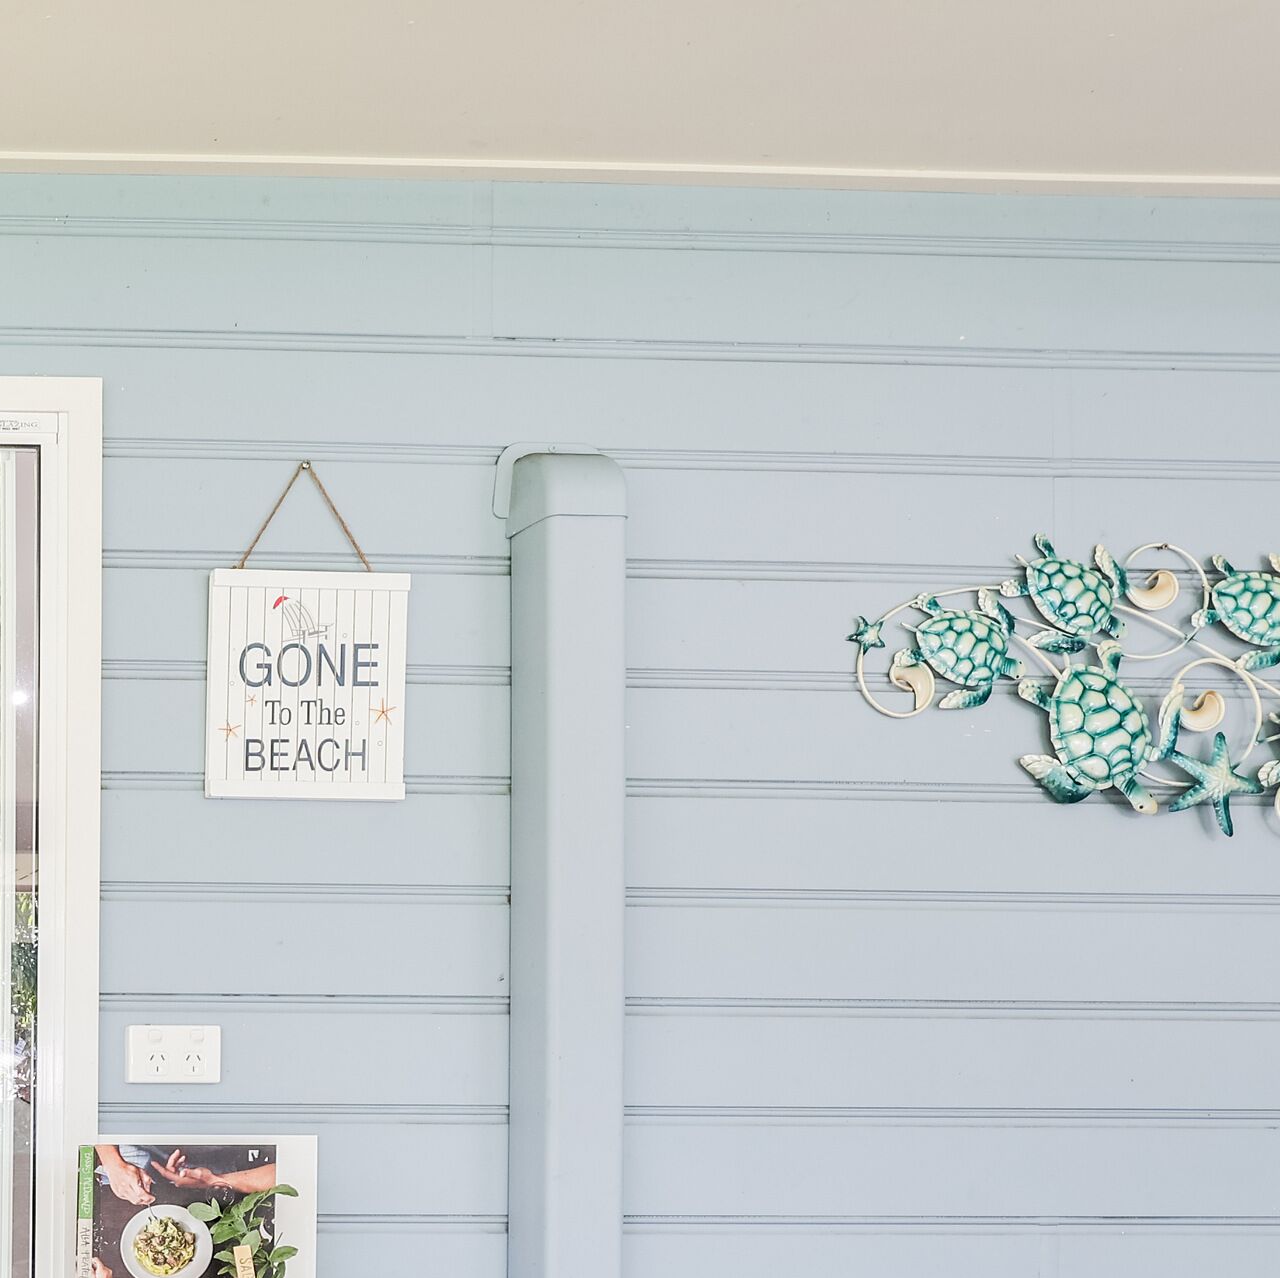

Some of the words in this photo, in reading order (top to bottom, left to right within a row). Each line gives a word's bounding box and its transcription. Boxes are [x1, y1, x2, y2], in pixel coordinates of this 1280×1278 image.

[239, 642, 379, 688] GONE
[264, 699, 292, 726] To
[300, 698, 346, 726] The
[244, 738, 367, 772] BEACH
